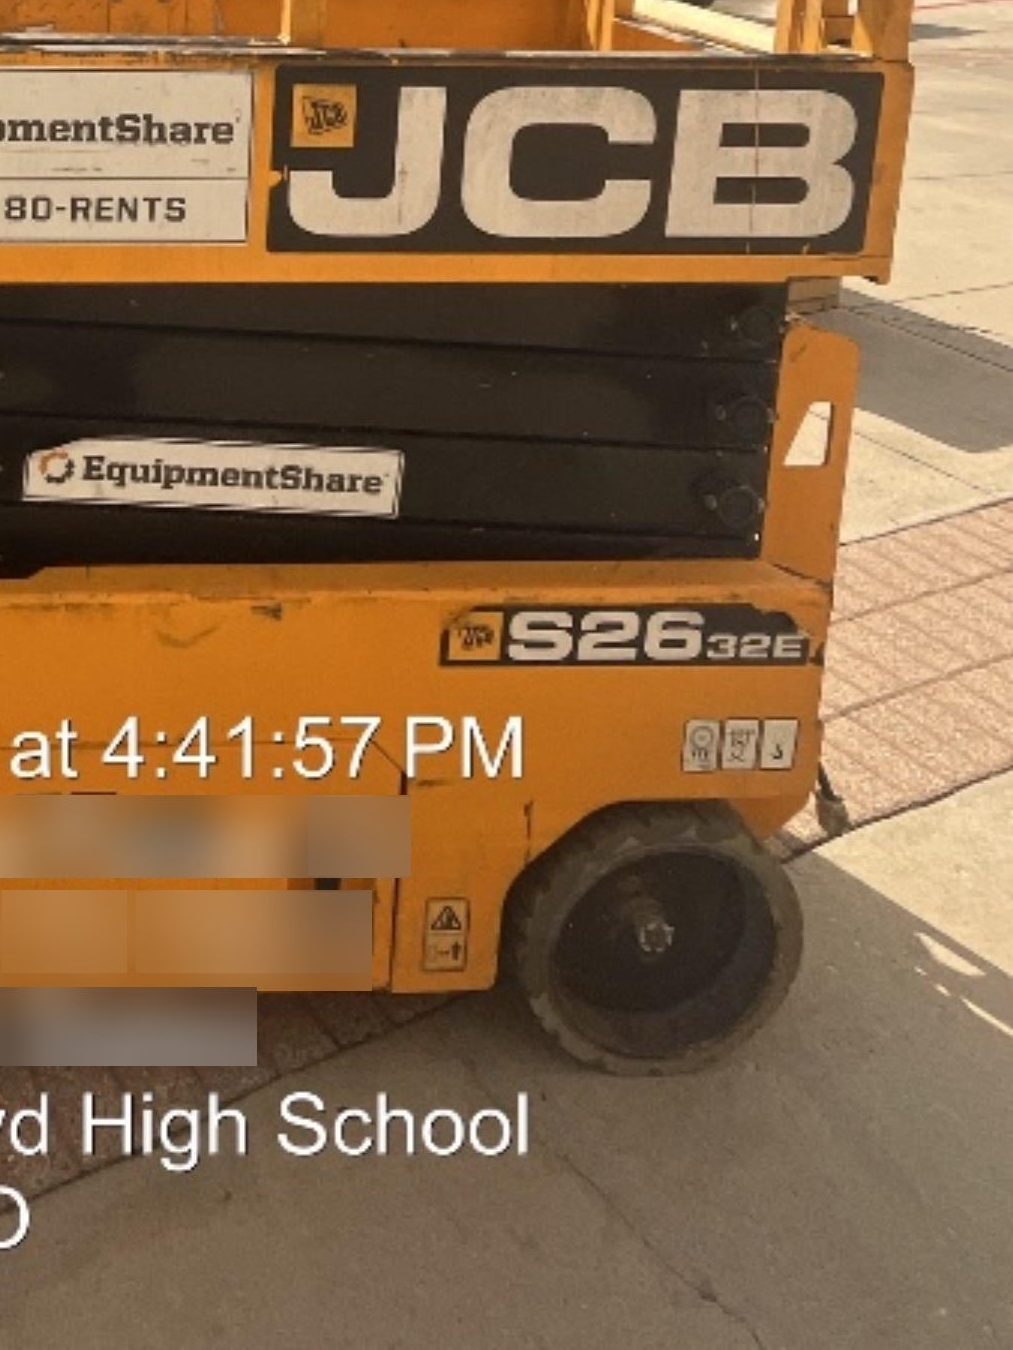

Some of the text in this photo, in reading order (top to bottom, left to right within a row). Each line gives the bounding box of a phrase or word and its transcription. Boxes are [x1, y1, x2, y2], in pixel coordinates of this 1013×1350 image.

[288, 84, 859, 239] JCB
[4, 196, 188, 224] 80-RENTS
[83, 456, 384, 494] EquipmentShare
[508, 610, 705, 662] S26
[706, 633, 804, 660] 32E
